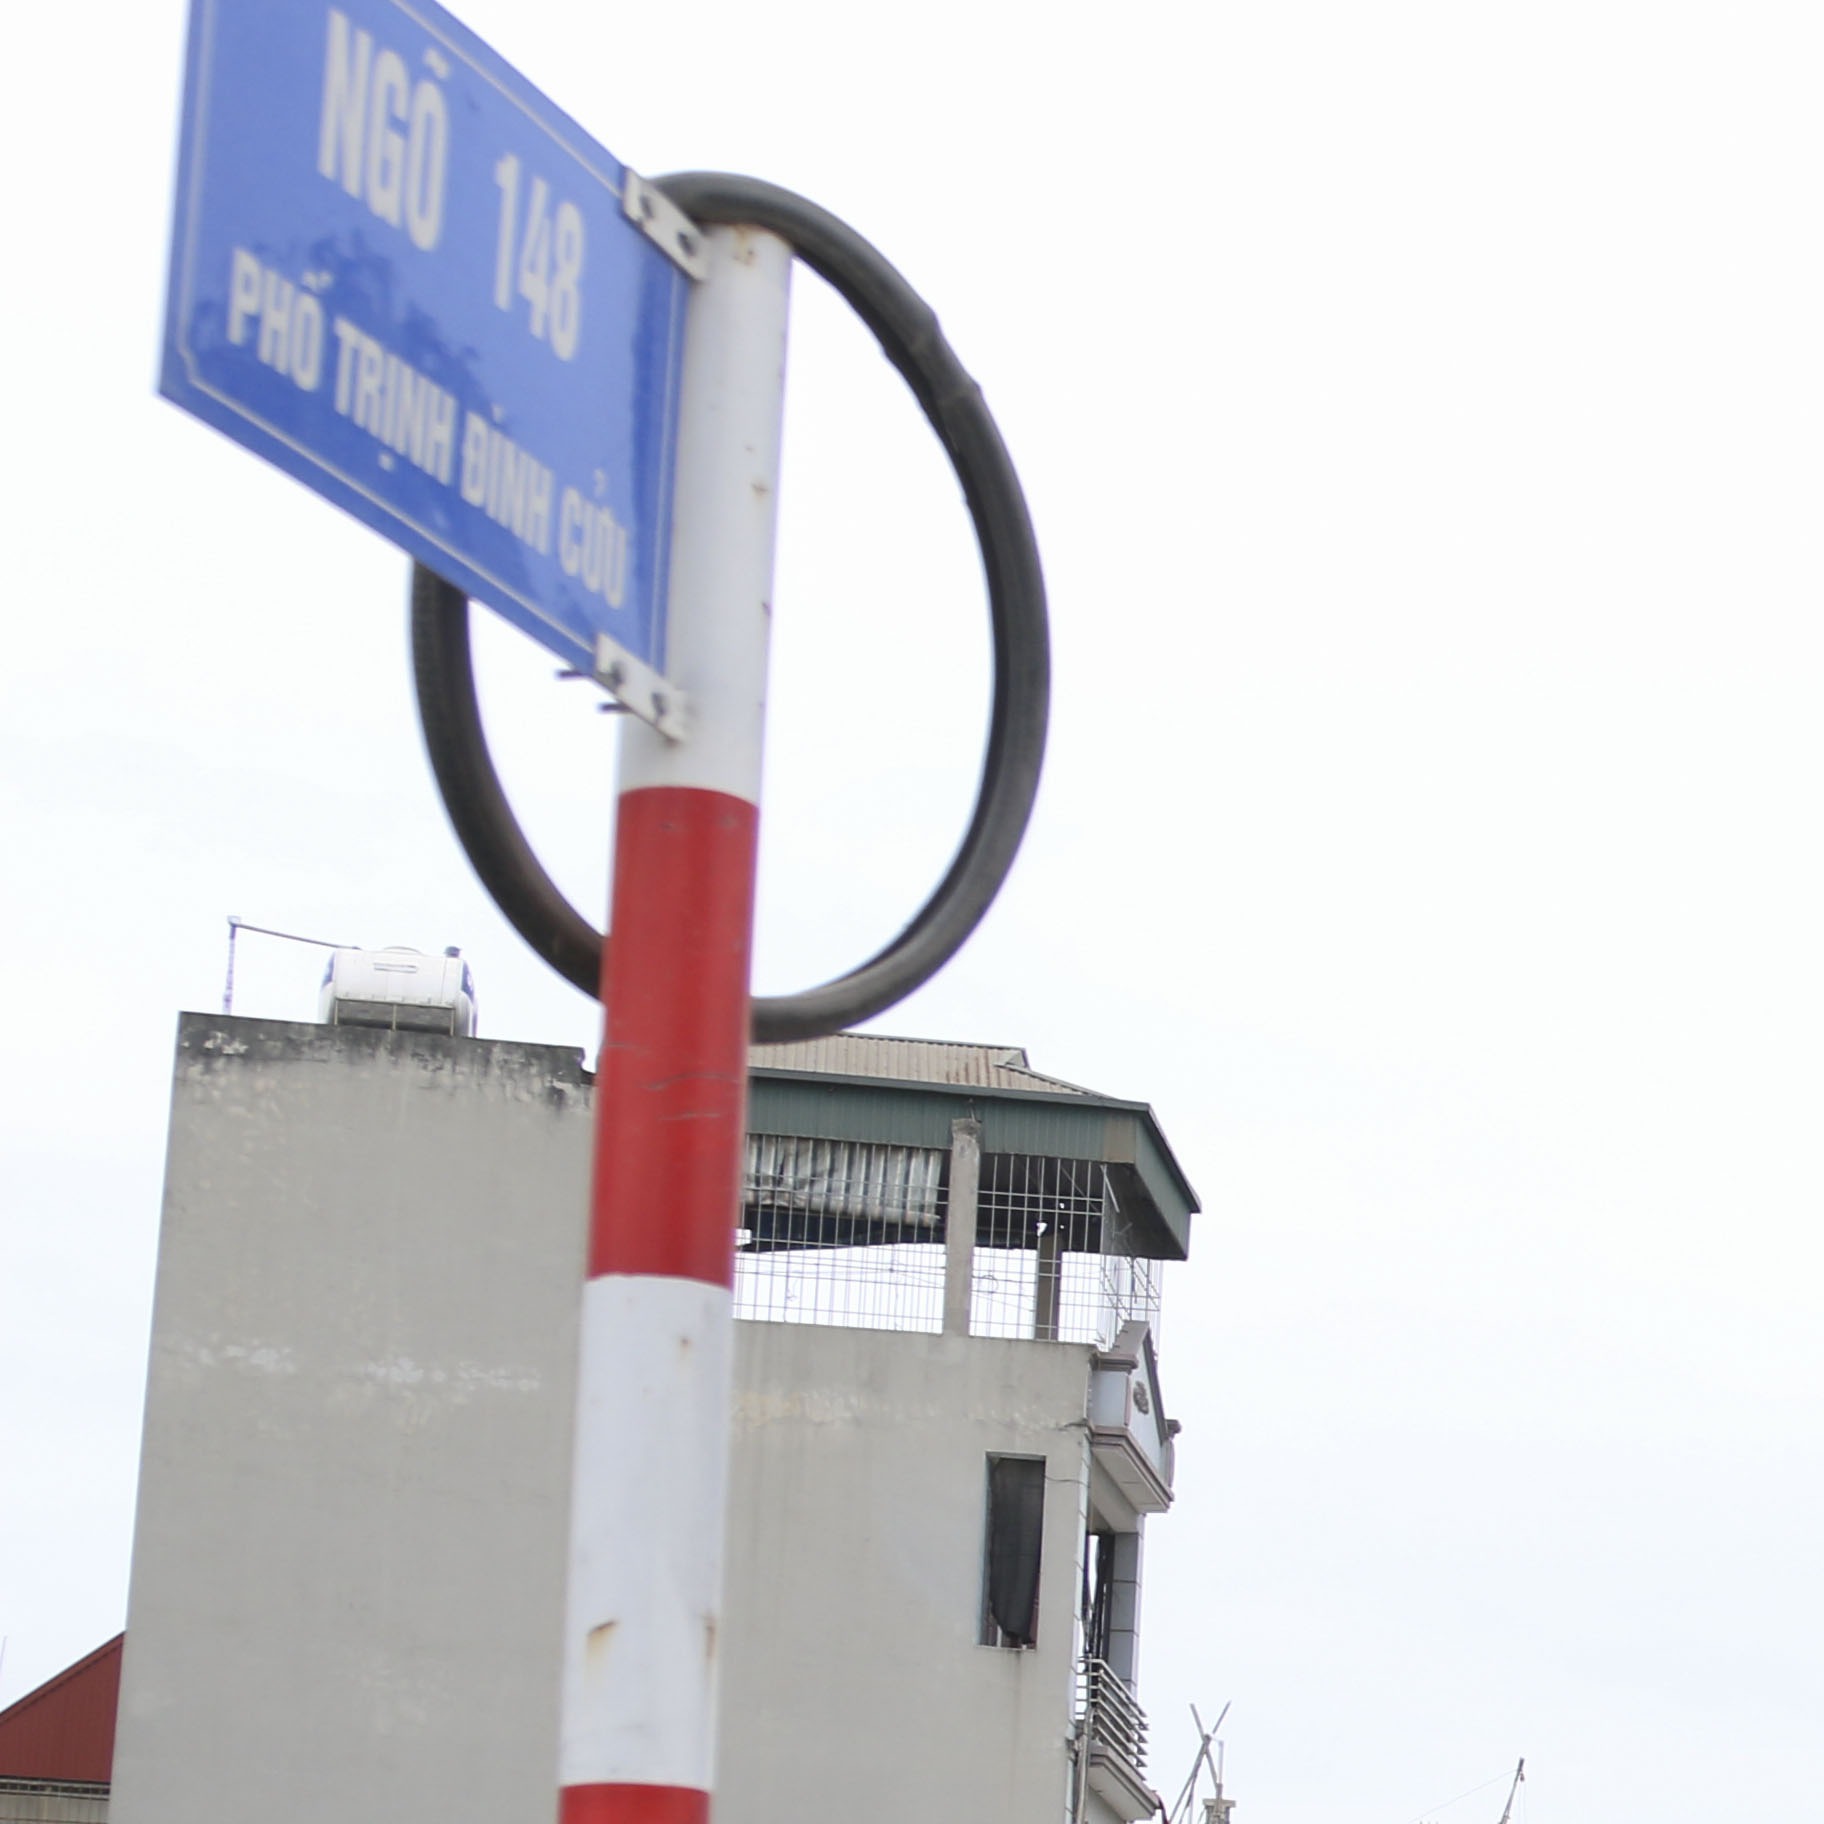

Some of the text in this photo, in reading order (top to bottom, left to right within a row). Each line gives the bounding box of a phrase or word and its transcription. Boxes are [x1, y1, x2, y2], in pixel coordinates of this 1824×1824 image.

[317, 4, 585, 361] NGÕ 148
[226, 246, 334, 393] PHỐ
[333, 314, 457, 488] TRỊNH
